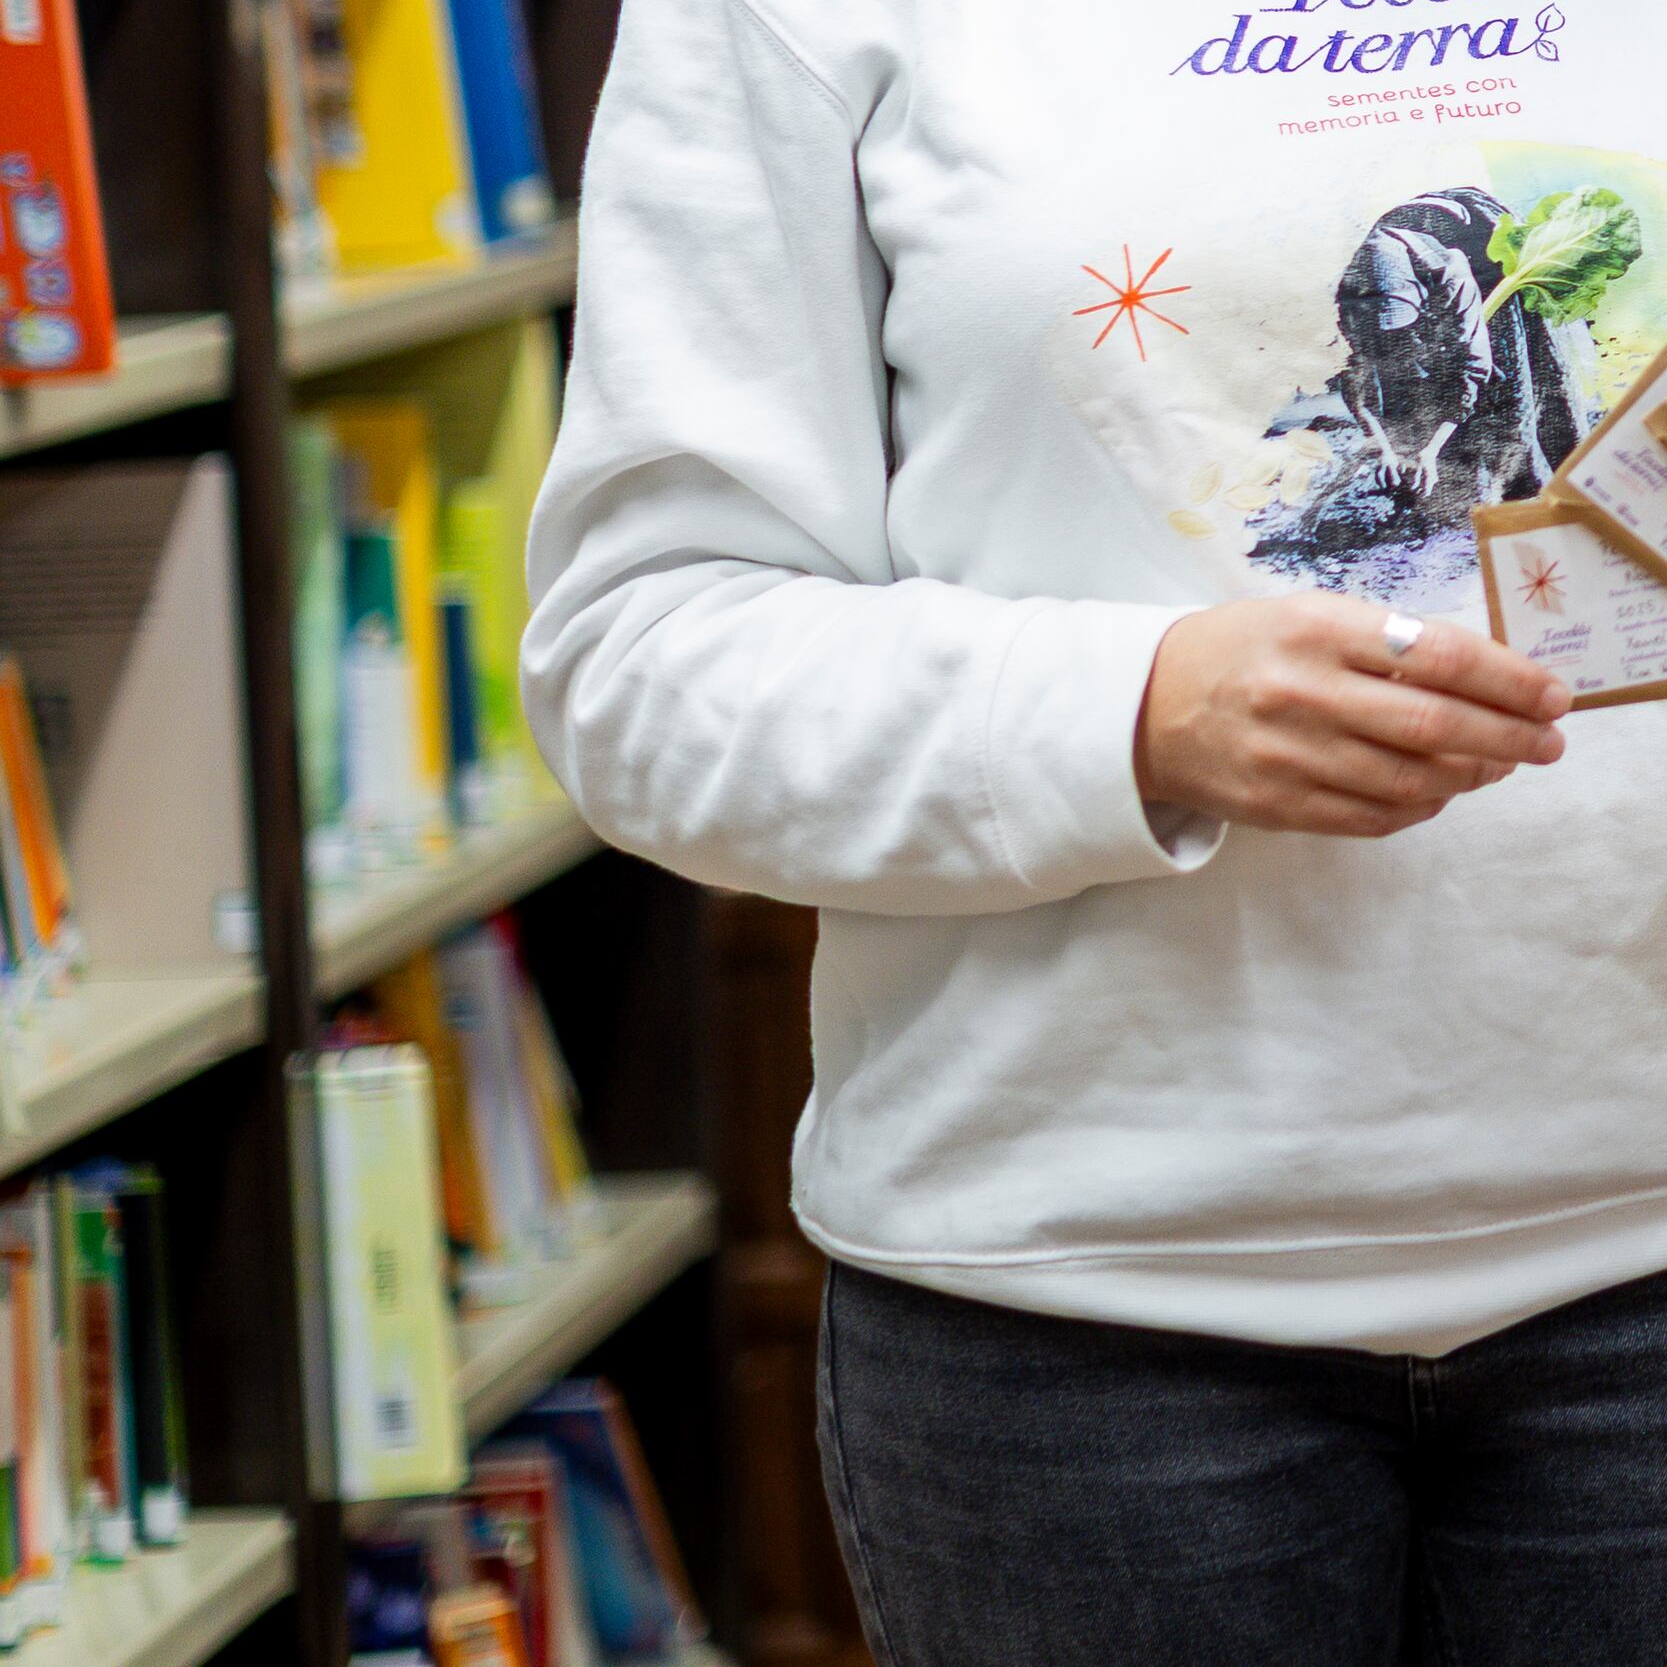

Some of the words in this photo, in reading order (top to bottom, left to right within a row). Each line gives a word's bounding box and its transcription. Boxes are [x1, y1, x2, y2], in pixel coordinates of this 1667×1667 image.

[1326, 80, 1456, 109] sementes
[1465, 75, 1518, 97] con
[1277, 109, 1400, 138] memoria
[1409, 106, 1425, 122] e
[1434, 97, 1523, 125] futuro
